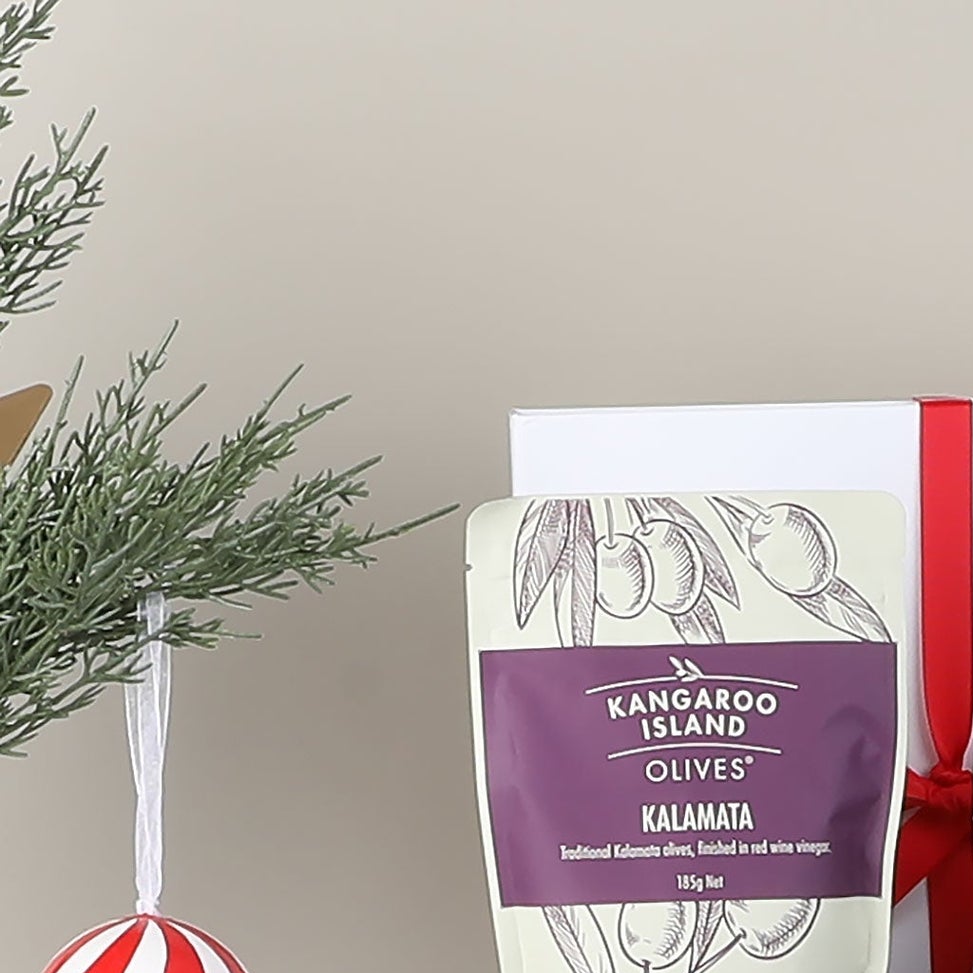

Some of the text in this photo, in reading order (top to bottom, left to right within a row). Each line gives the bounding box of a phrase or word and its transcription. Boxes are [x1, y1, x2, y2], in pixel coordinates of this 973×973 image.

[607, 688, 777, 720] KANGAROO
[641, 713, 745, 740] ISLAND
[642, 801, 754, 833] KALAMATA
[560, 844, 611, 860] Traditional
[613, 843, 661, 858] Kalamata
[698, 840, 736, 855] finished
[739, 840, 749, 855] in
[750, 839, 768, 855] red
[769, 839, 794, 854] wine
[676, 873, 724, 892] 185g Net
